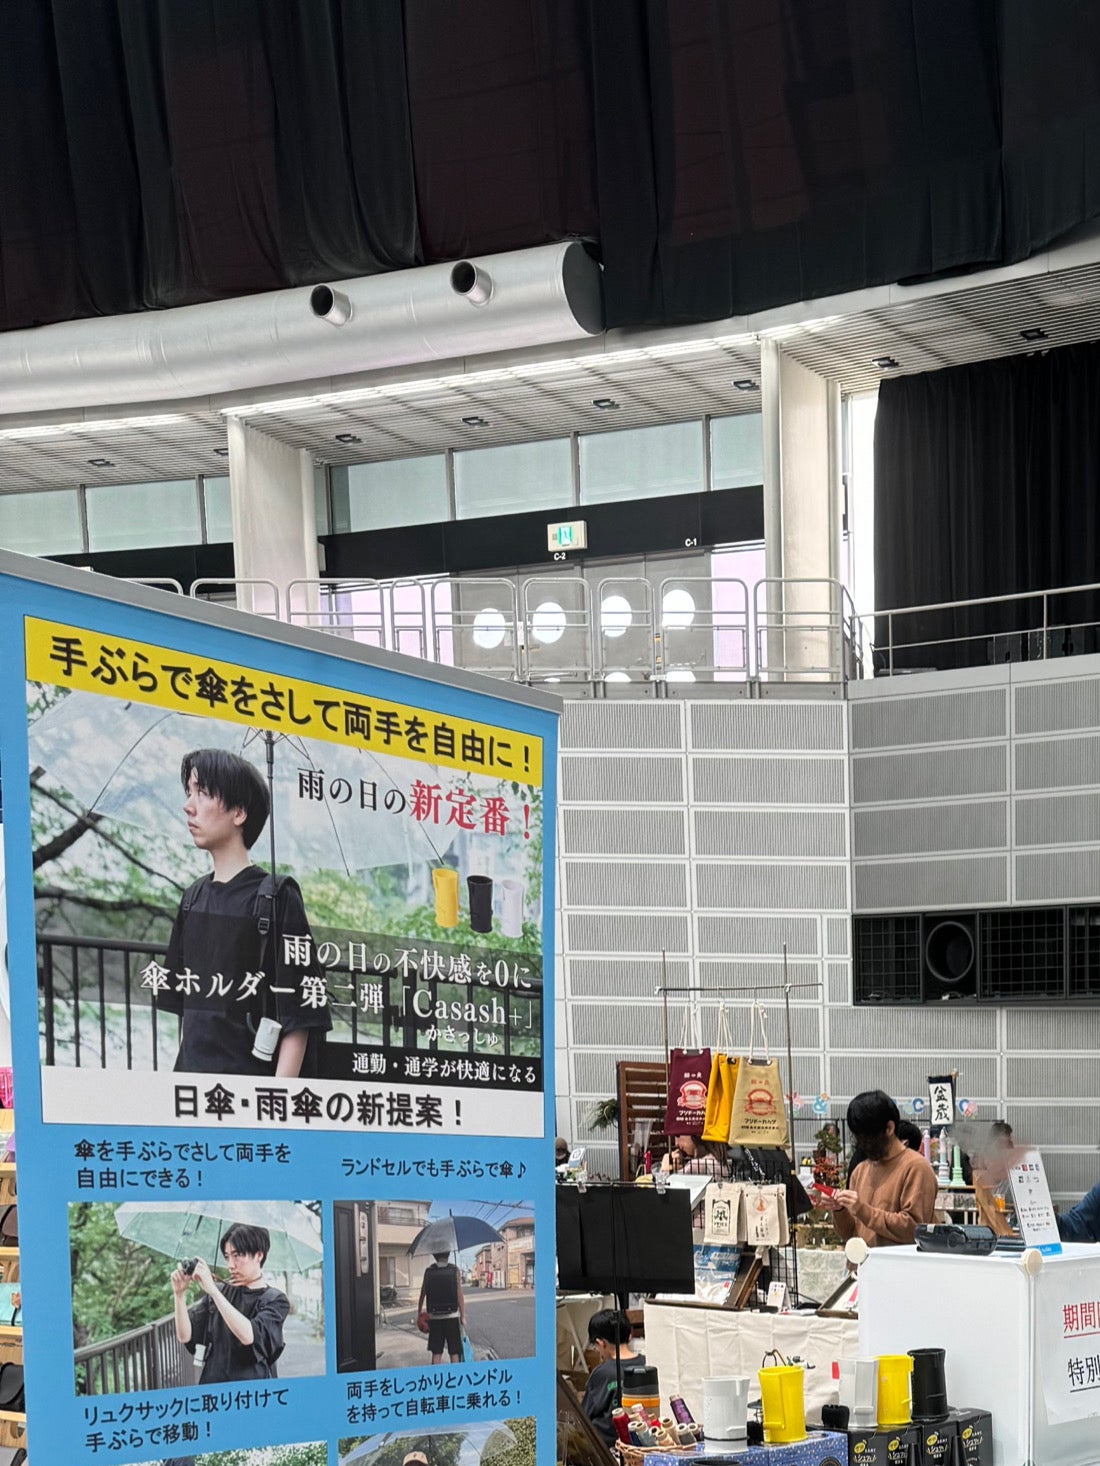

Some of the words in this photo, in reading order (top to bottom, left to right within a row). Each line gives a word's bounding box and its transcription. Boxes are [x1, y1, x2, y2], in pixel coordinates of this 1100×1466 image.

[553, 552, 566, 561] C-2
[684, 538, 697, 547] C-1
[49, 635, 532, 774] 手ぶらで傘をさして両手を自由に！
[297, 767, 532, 840] 雨の日の新定番！
[425, 1022, 499, 1047] かさっしゅ
[351, 1051, 537, 1085] 通勤・通学が快適になる
[173, 1083, 462, 1127] 日傘・雨傘の新提案！
[73, 1139, 291, 1164] 傘を手ぶらでさして両手を
[76, 1166, 203, 1189] 自由にできる！
[346, 1368, 513, 1400] 両手をしっかりとハンドル
[83, 1388, 289, 1427] リュクサックに取り付けて
[346, 1390, 522, 1425] を持って自転車に乗れる！
[84, 1420, 212, 1453] 手ぶらで移動！
